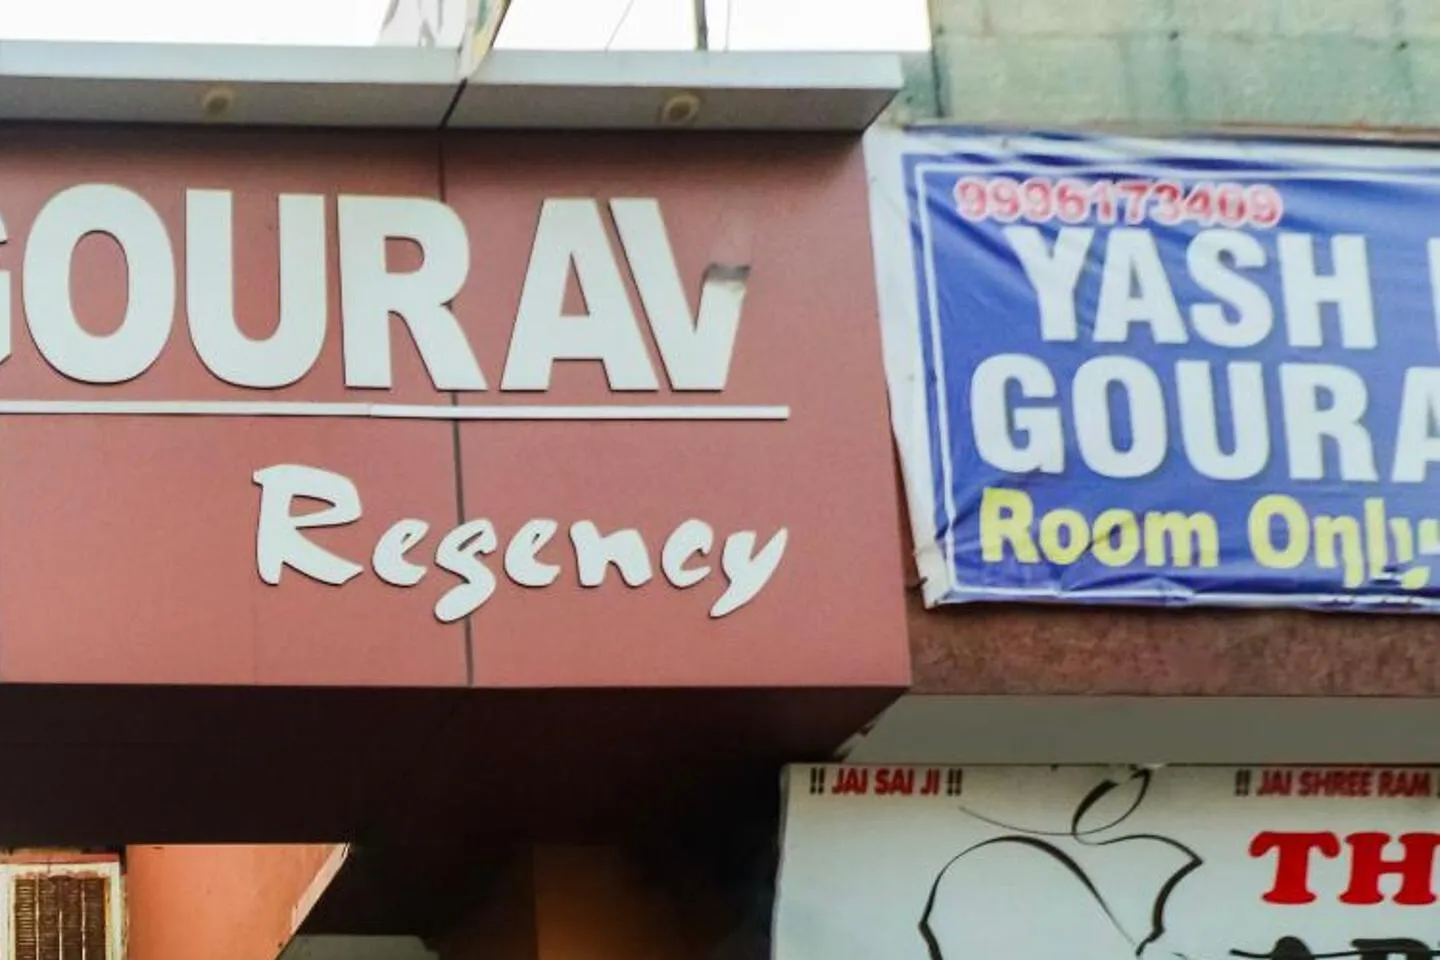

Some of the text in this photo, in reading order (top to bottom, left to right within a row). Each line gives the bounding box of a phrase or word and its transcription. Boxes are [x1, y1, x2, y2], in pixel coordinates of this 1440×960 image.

[1004, 226, 1378, 349] YASH
[252, 463, 789, 623] Regency
[978, 487, 1220, 568] Room
[832, 767, 867, 795] JAI
[874, 767, 914, 796] SAI
[920, 768, 940, 796] JI
[1257, 770, 1293, 797] JAI
[1298, 770, 1372, 798] SHREE
[1378, 770, 1432, 798] RAM
